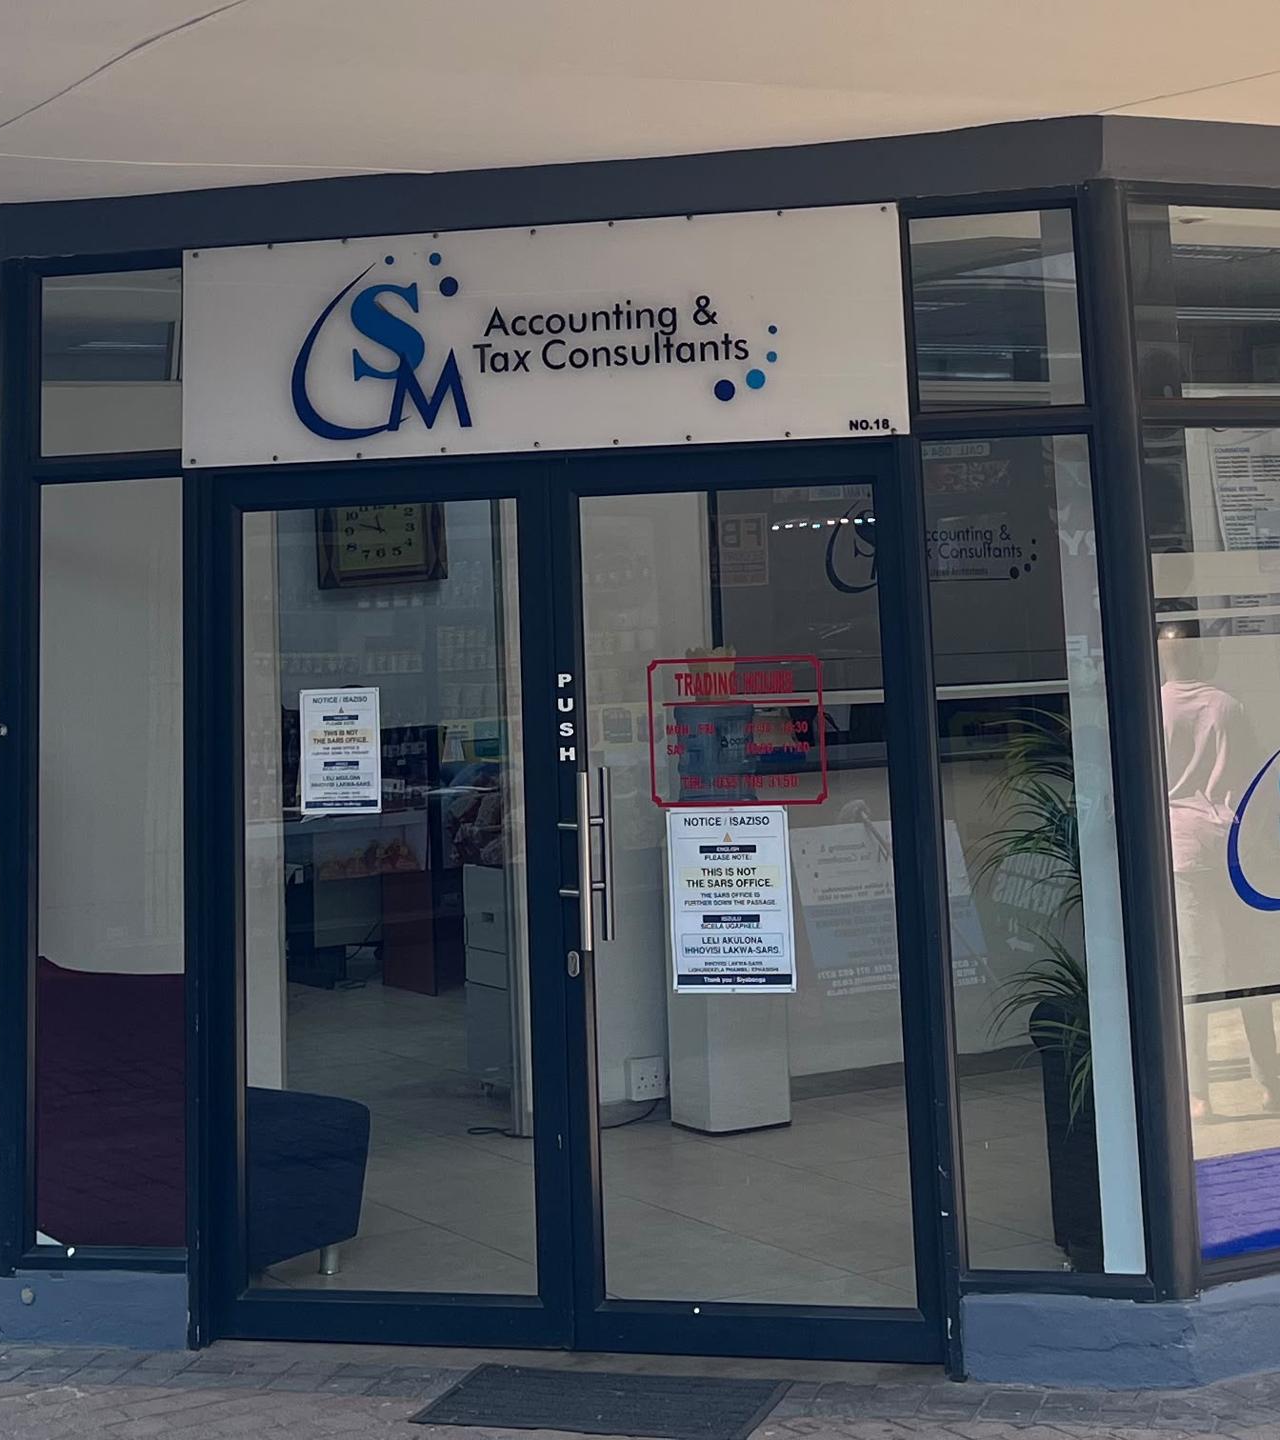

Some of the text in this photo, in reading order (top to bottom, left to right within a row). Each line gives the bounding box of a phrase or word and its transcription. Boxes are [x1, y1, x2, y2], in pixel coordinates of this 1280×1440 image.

[483, 295, 719, 337] Accounting &
[472, 332, 750, 375] Tax Consultants
[849, 419, 890, 431] NO.18
[926, 524, 1011, 544] ccounting &
[938, 542, 1023, 560] Consultants
[557, 673, 576, 761] PUSH
[684, 816, 721, 827] NOTICE
[729, 816, 770, 826] ISAZISO
[701, 867, 757, 876] THIS IS NOT
[686, 878, 773, 888] THE SARS OFFICE.
[702, 936, 763, 945] LELI AKULONA
